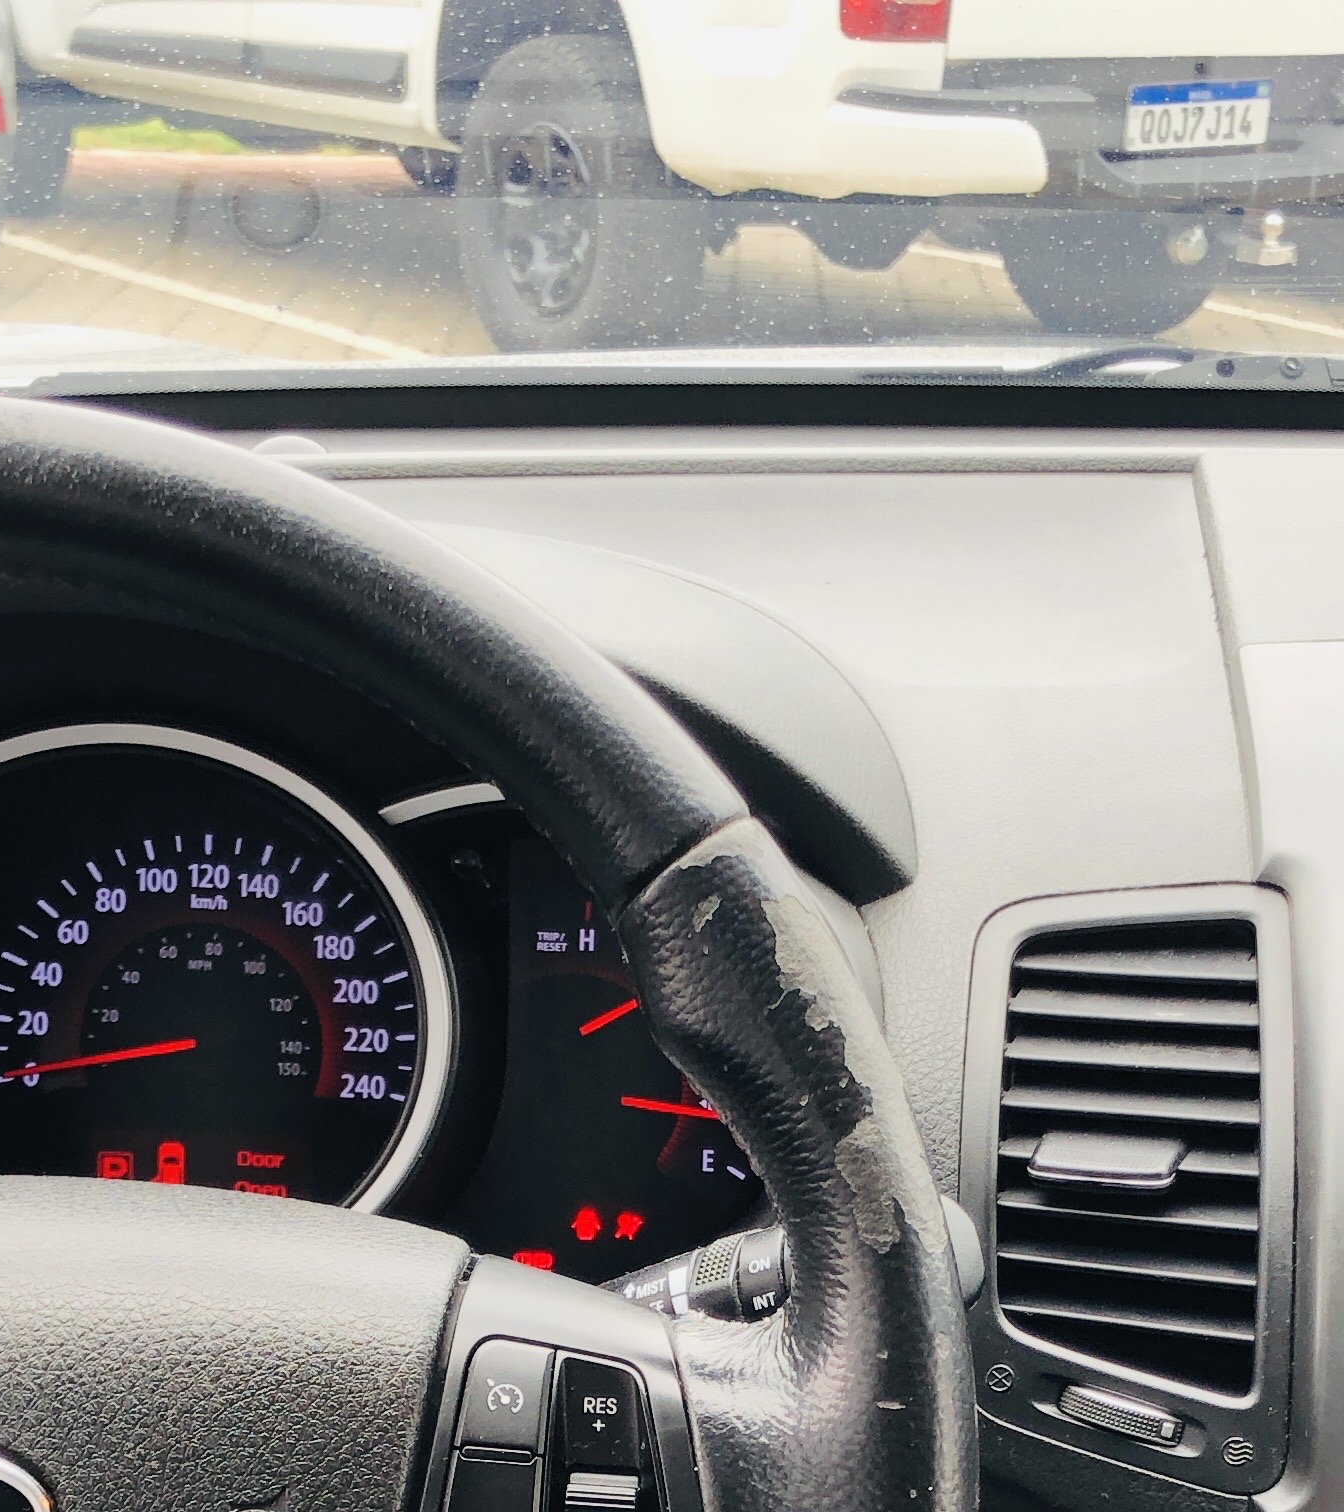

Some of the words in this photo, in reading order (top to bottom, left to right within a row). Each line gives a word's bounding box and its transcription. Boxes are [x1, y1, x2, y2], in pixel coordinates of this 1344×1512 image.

[135, 867, 178, 893] 100
[188, 863, 231, 889] 120
[237, 873, 279, 899] 140
[94, 887, 127, 913] 80
[190, 893, 229, 911] km/h
[281, 901, 324, 927] 160
[57, 919, 90, 945] 60
[579, 928, 595, 952] H
[159, 945, 178, 959] 60
[313, 935, 355, 961] 180
[536, 941, 568, 952] RESET
[30, 962, 63, 987] 40
[121, 971, 140, 984] 40
[332, 979, 379, 1004] 200
[101, 1008, 119, 1022] 20
[270, 998, 292, 1012] 120
[17, 1010, 49, 1036] 20
[343, 1027, 389, 1053] 220
[278, 1062, 300, 1076] 150
[340, 1074, 385, 1099] 240
[236, 1151, 284, 1168] Door
[702, 1149, 715, 1172] E
[748, 1256, 771, 1274] ON
[635, 1277, 667, 1300] MIST
[752, 1291, 777, 1311] INT
[583, 1396, 618, 1415] RES
